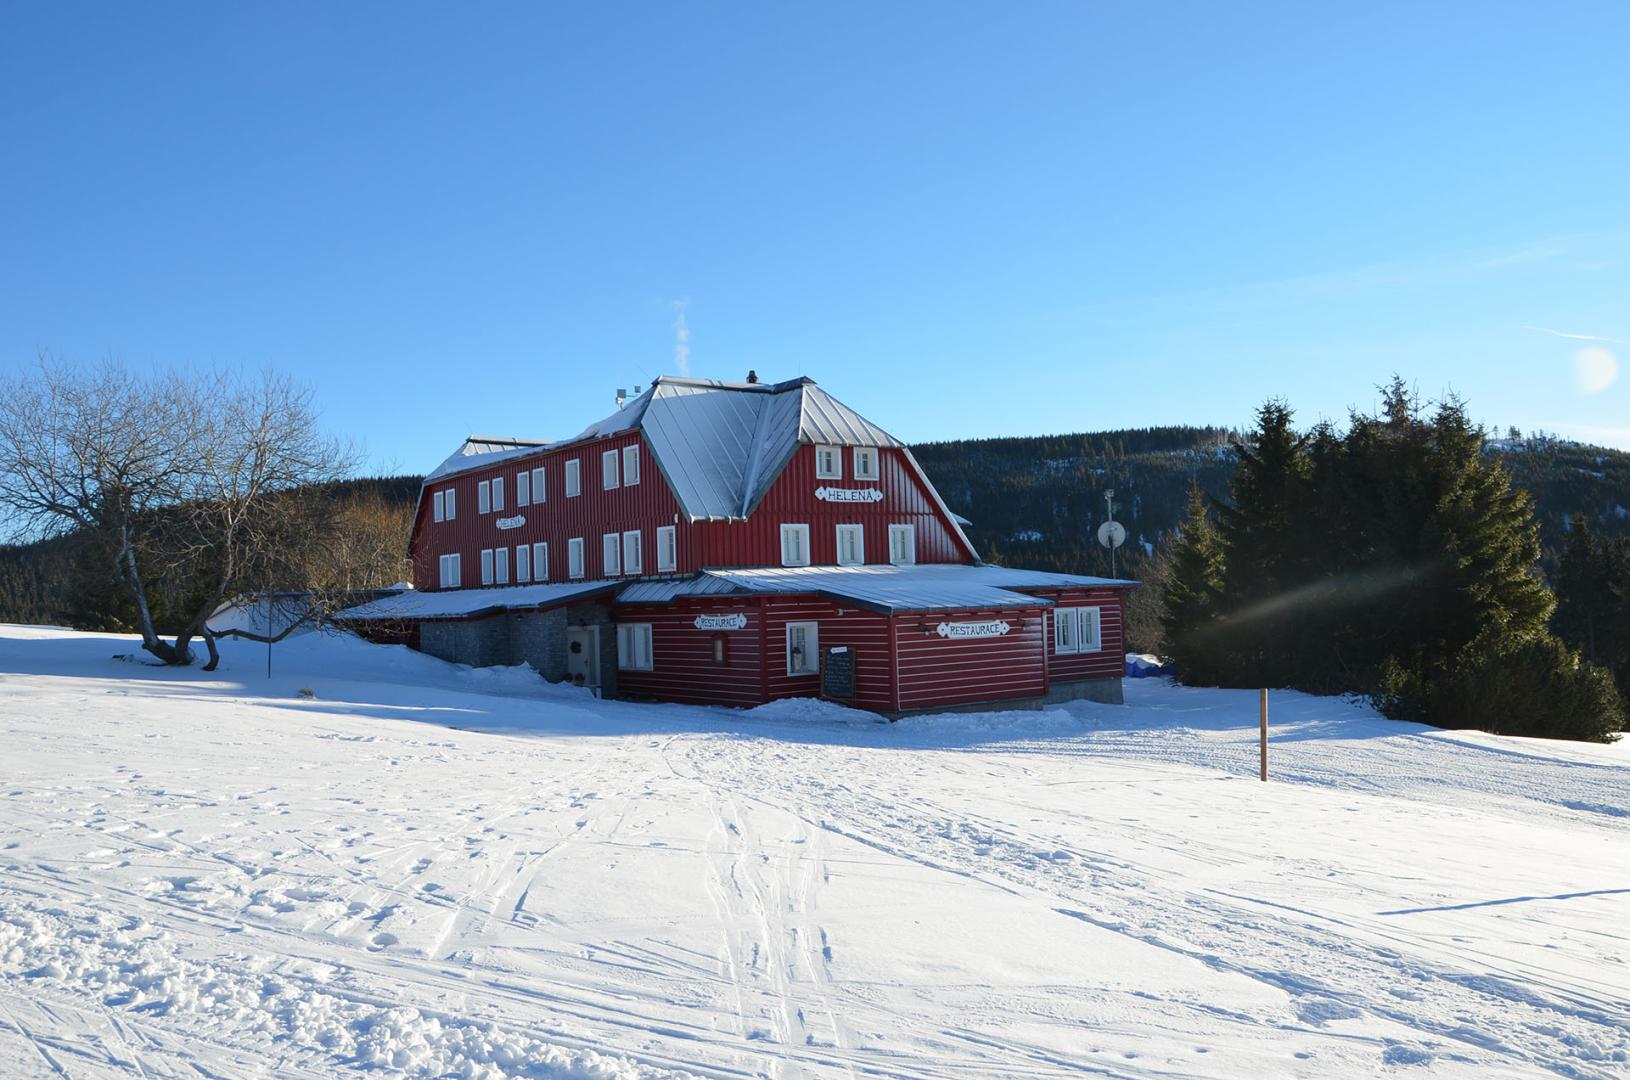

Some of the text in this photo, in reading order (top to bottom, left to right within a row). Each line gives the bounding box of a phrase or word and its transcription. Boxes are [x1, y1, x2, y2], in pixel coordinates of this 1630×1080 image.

[828, 490, 873, 501] HELENA
[701, 617, 737, 628] RESTAURACE
[950, 623, 1000, 636] RESTAURACE
